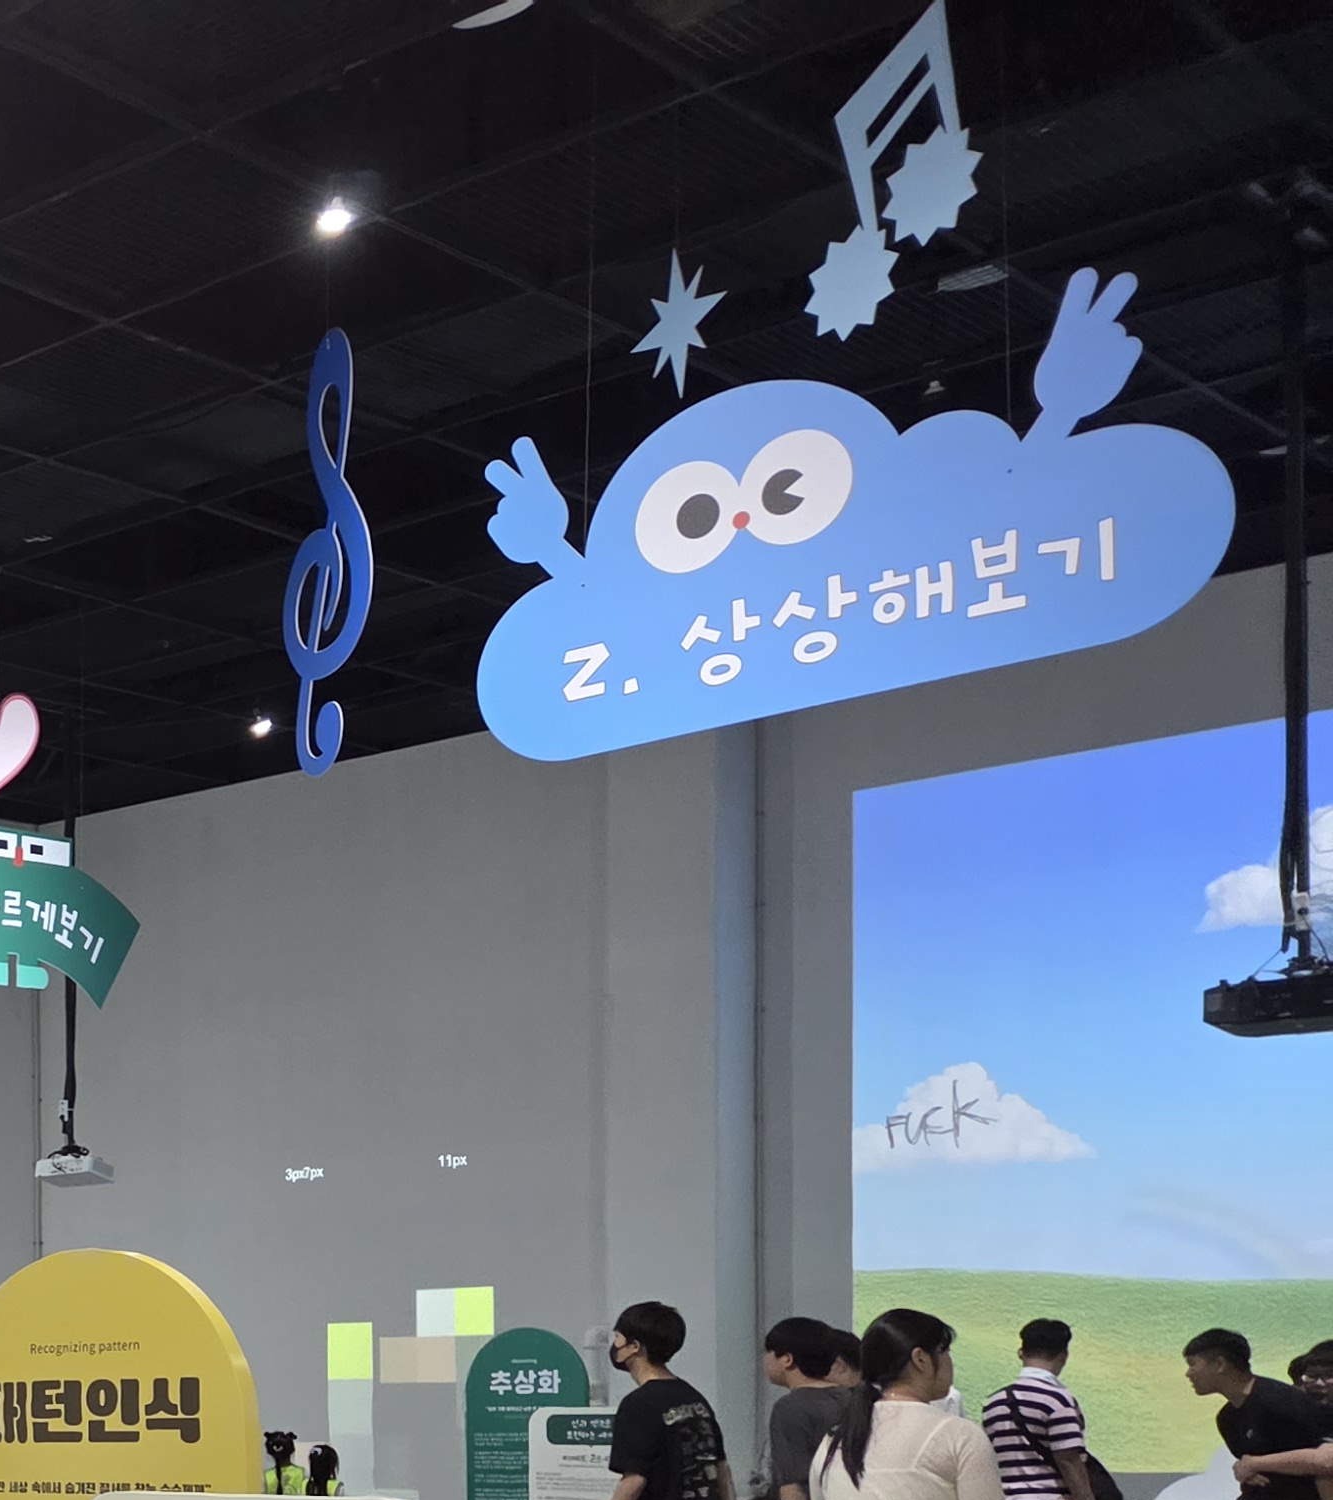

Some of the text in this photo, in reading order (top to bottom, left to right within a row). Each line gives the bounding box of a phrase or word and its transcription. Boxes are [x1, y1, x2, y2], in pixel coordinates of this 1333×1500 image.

[680, 515, 1116, 688] 상상해보기
[30, 1340, 140, 1357] Recognizing pattern
[489, 1369, 562, 1396] 추상화
[9, 1481, 28, 1493] 세상
[31, 1481, 61, 1494] 속에서
[65, 1482, 96, 1494] 숨겨진
